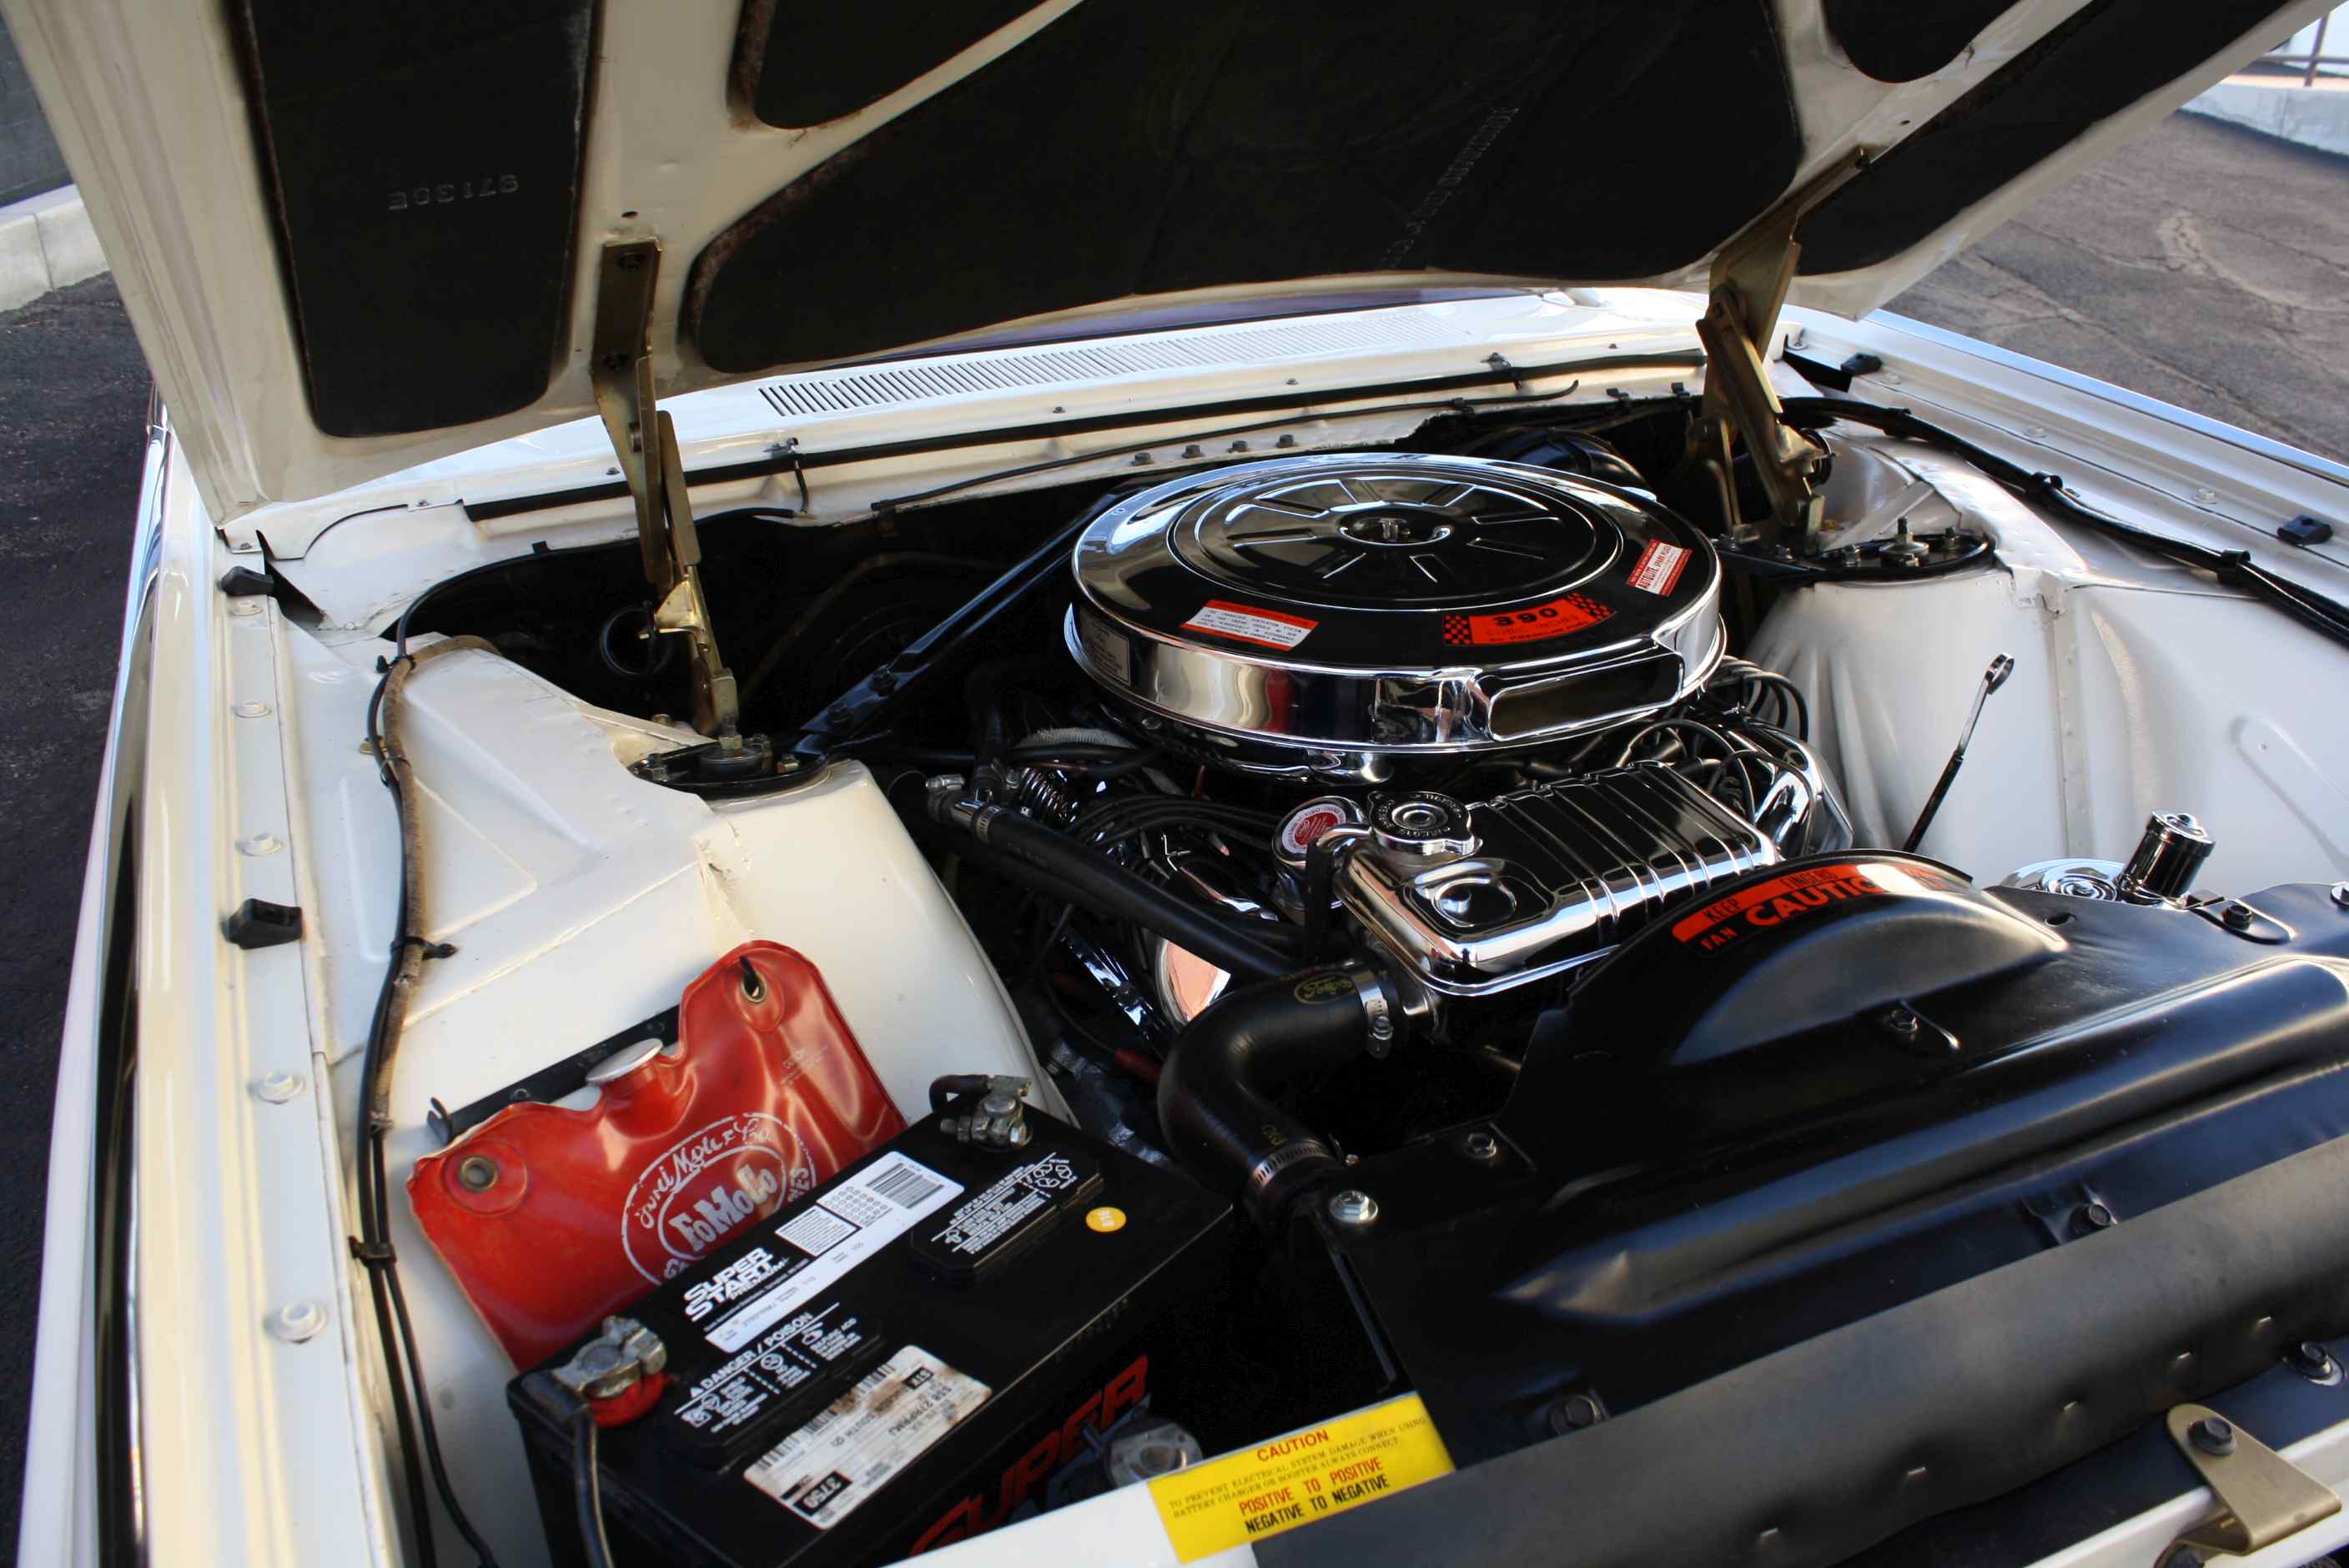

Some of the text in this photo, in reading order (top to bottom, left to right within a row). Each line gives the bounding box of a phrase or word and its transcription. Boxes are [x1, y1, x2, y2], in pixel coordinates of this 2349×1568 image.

[1493, 608, 1558, 627] 390
[1700, 927, 1738, 951] FAN
[1745, 876, 1884, 926] CAUTIO
[1703, 869, 1835, 923] KEEP FINGERS
[669, 1163, 778, 1252] FoMoCo
[683, 1247, 769, 1301] SUPER
[685, 1254, 773, 1322] START
[701, 1349, 757, 1390] DANGER
[763, 1311, 814, 1347] POISON
[1174, 1500, 1216, 1518] BATTERY
[1218, 1486, 1261, 1505] CHARGER
[1277, 1465, 1318, 1485] BOOSTER
[1321, 1452, 1357, 1474] ALWAYS
[1358, 1436, 1401, 1460] CONNECT
[1185, 1485, 1229, 1505] PREVENT
[1233, 1464, 1288, 1489] ELECTRICAL
[1292, 1452, 1326, 1472] SYSTEM
[1330, 1438, 1369, 1460] DAMAGE
[1370, 1429, 1396, 1447] WHEN
[1399, 1418, 1426, 1436] USING
[1257, 1430, 1330, 1462] CAUTION
[1239, 1456, 1383, 1518] POSITIVE TO POSITIVE
[1245, 1474, 1390, 1535] NEGATIVE TO NEGATIVE
